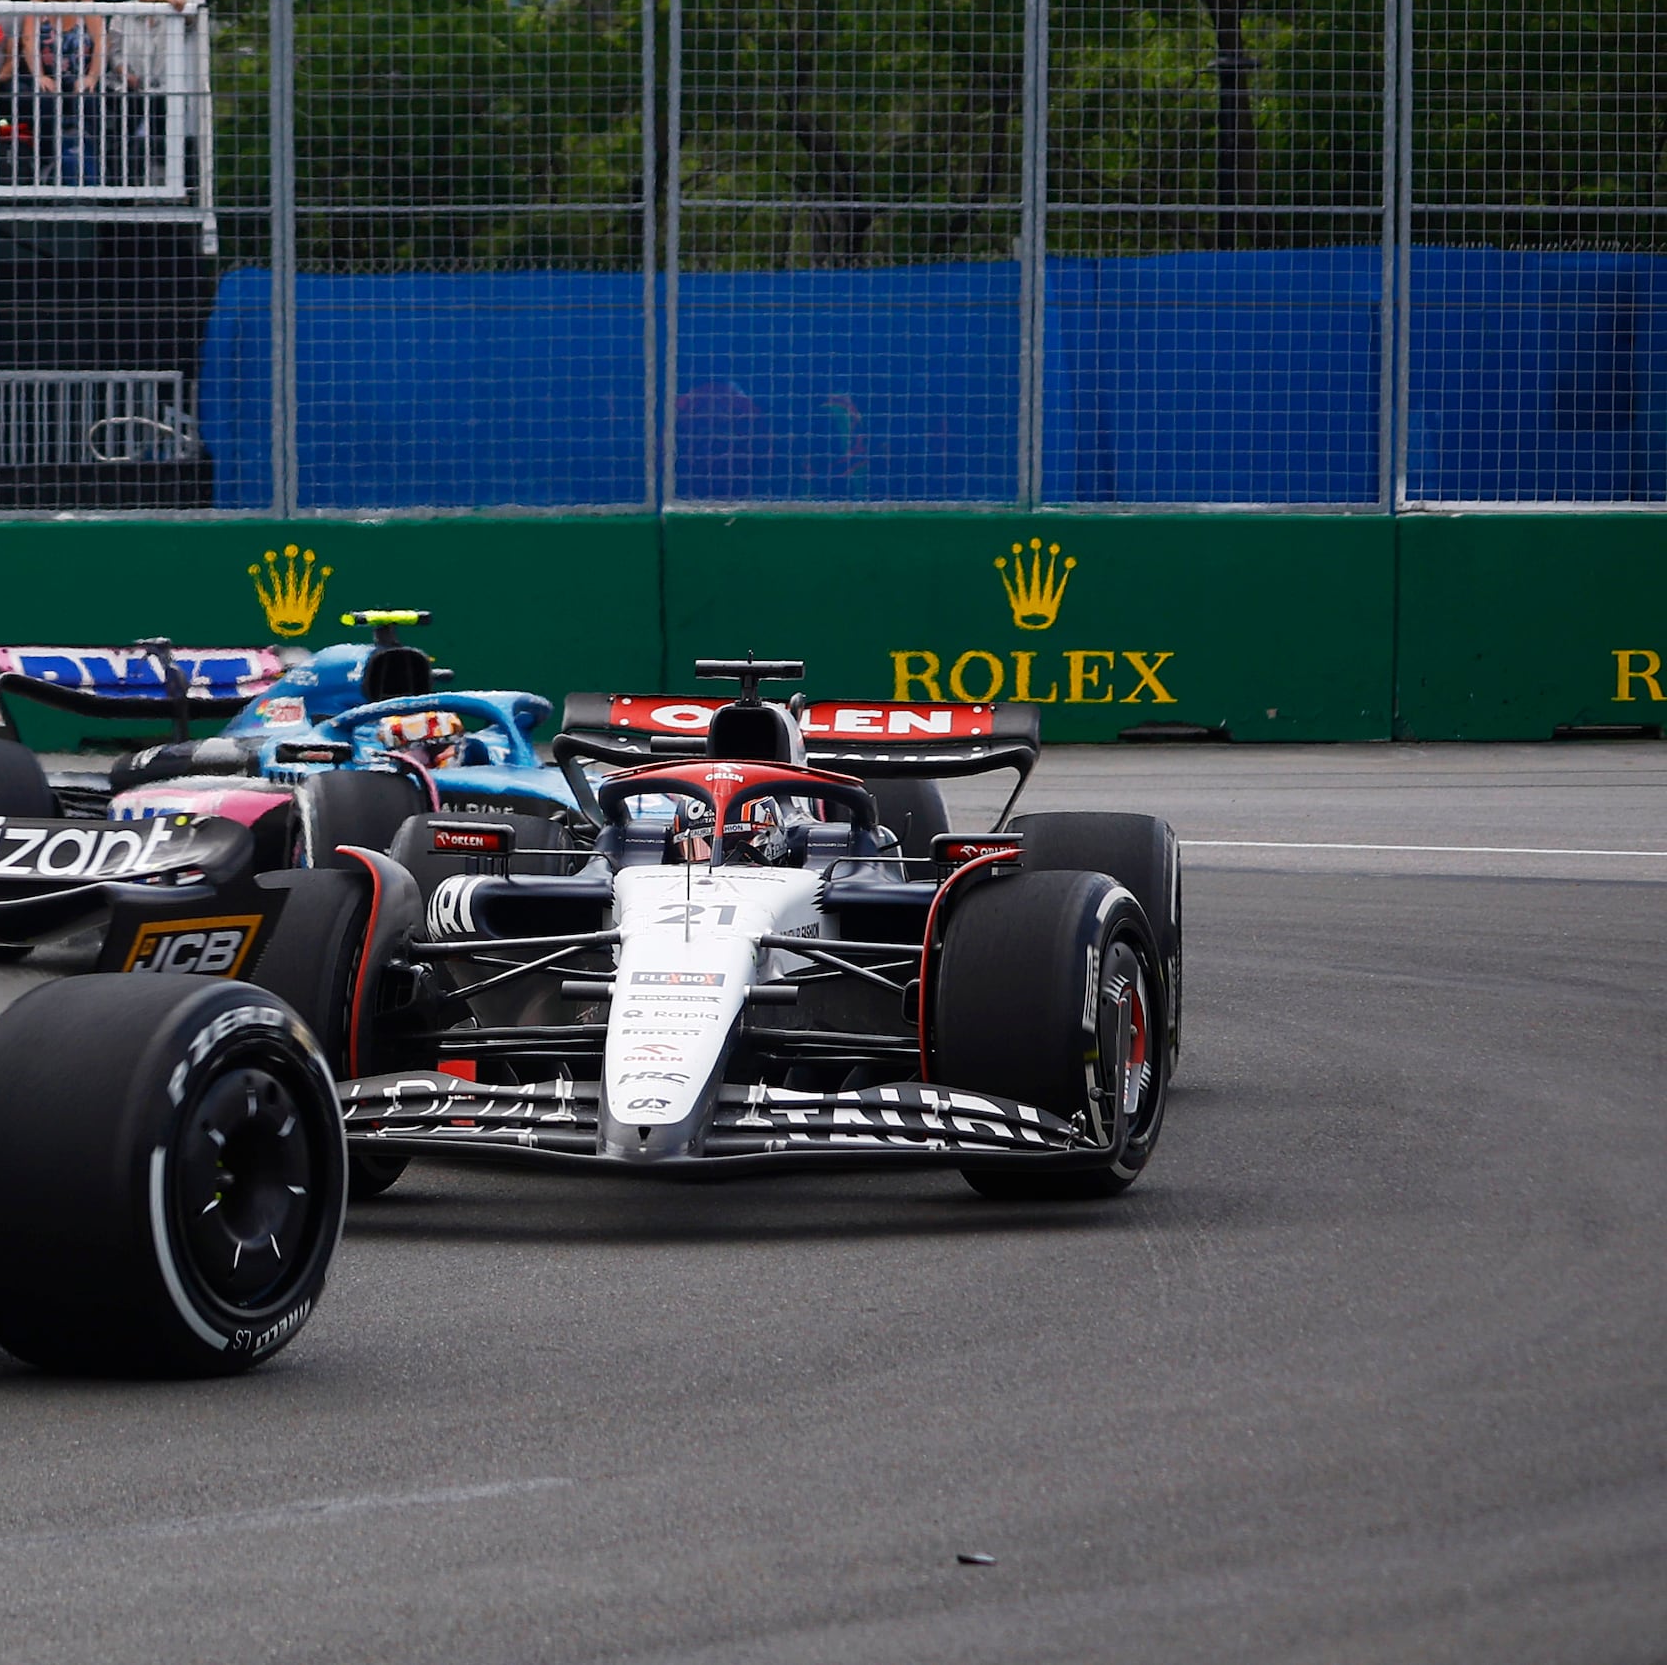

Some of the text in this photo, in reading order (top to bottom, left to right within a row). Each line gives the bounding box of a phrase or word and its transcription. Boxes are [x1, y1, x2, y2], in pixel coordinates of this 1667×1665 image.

[889, 649, 1179, 705] ROLEX
[650, 703, 953, 736] OLEN
[705, 772, 745, 784] ORLEN
[450, 836, 484, 847] ORLEN
[652, 903, 739, 927] 21
[132, 929, 244, 975] JCB
